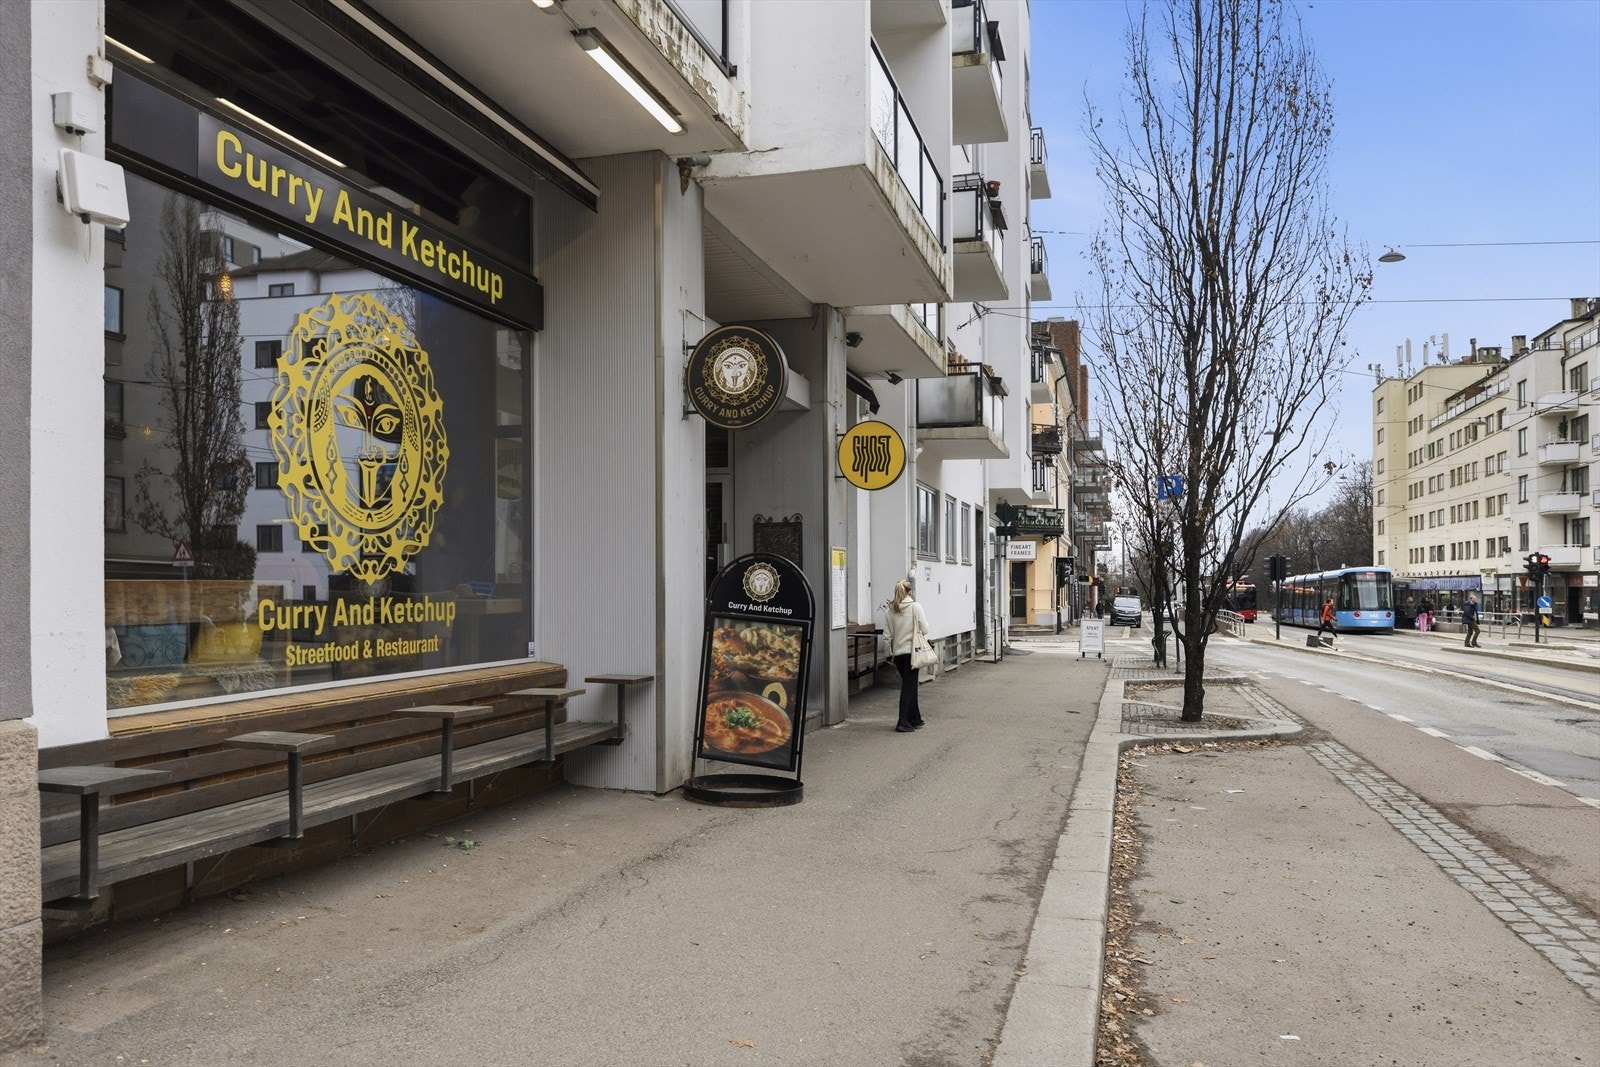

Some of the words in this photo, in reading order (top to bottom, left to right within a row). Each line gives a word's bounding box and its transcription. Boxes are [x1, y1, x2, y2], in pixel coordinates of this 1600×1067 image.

[216, 130, 323, 224] Curry
[333, 190, 393, 248] And
[401, 220, 503, 304] Ketchup
[695, 386, 719, 413] CURRY
[718, 408, 738, 418] AND
[740, 384, 775, 417] KETCHUP
[852, 435, 892, 483] GHOST
[258, 598, 328, 636] Curry
[333, 597, 375, 627] And
[380, 595, 456, 627] Ketchup
[728, 601, 748, 611] Curry
[748, 603, 762, 612] And
[763, 605, 793, 615] Ketchup
[285, 640, 358, 667] Streetfood
[363, 639, 373, 659] &
[376, 634, 439, 658] Restaurant
